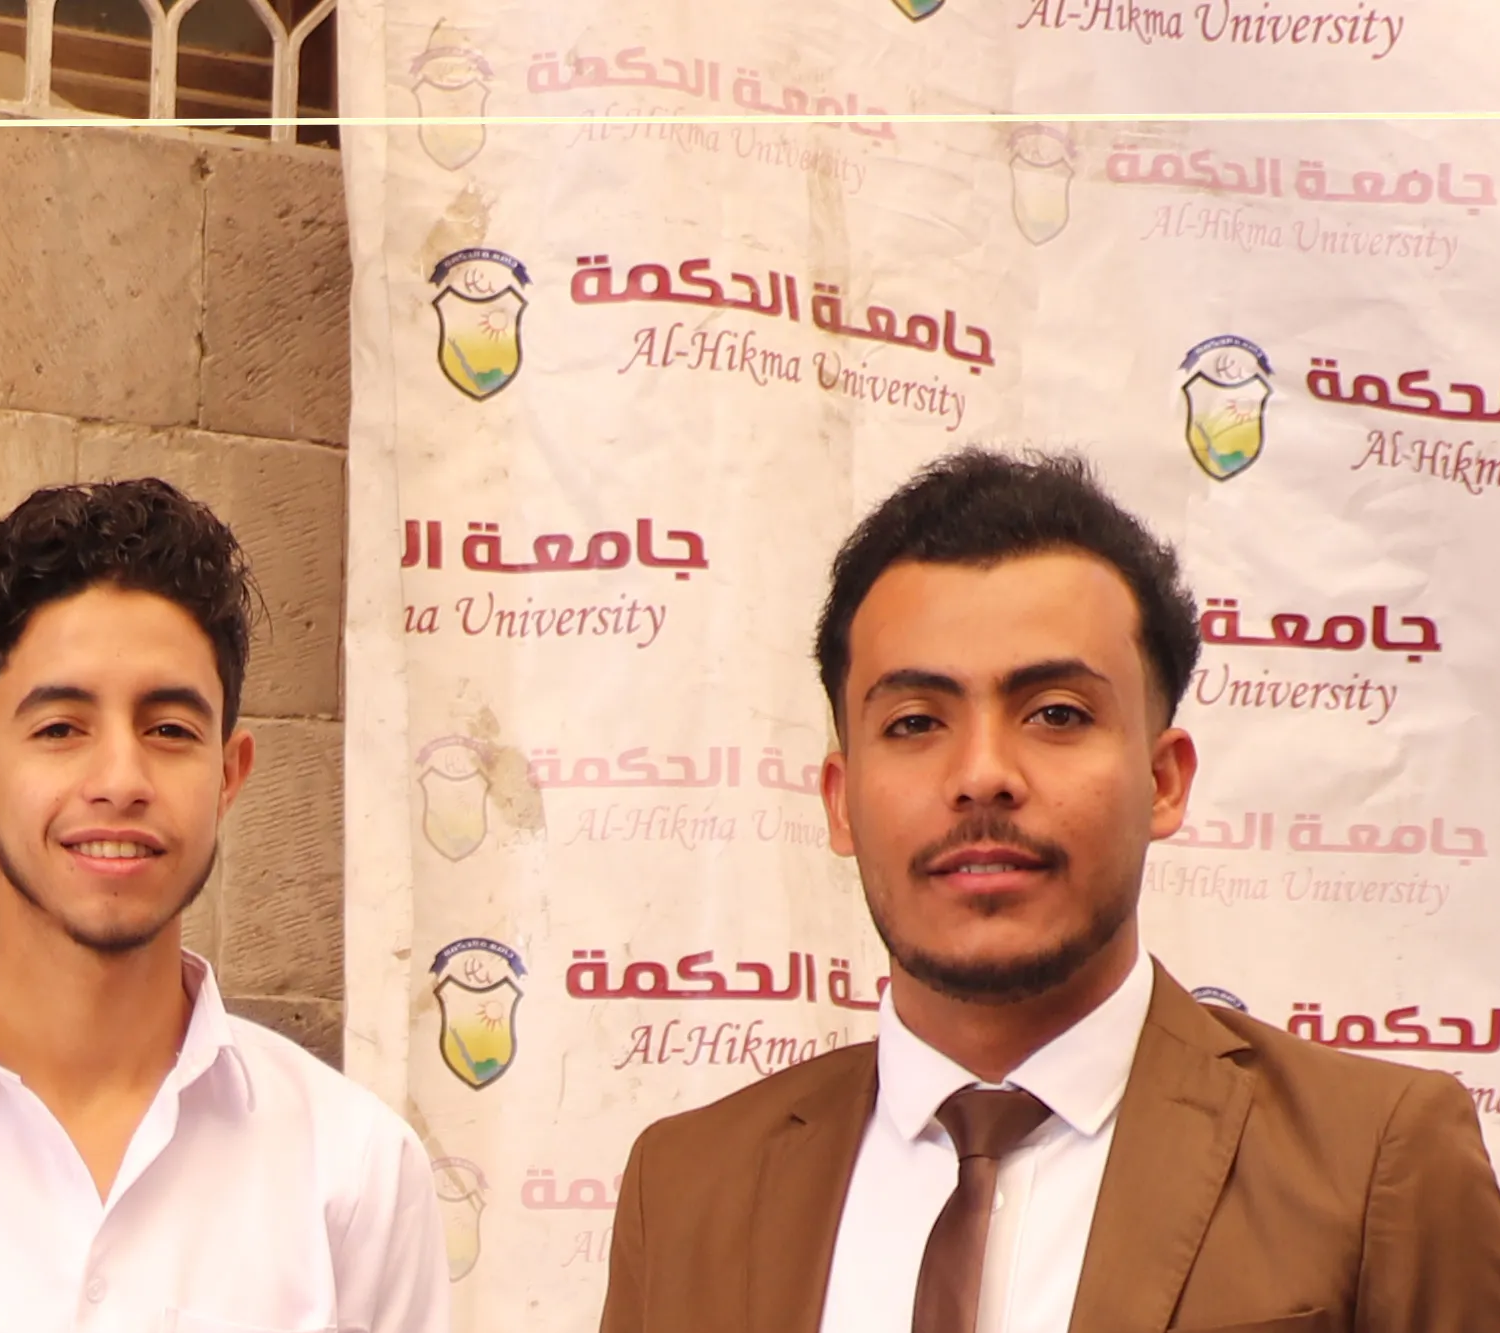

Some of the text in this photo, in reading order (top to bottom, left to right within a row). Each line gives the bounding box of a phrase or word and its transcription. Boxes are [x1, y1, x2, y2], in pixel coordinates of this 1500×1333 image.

[1106, 143, 1498, 216] جامعة الحكمة
[571, 254, 995, 374] جامعة الحكمة
[618, 323, 966, 431] Al-Hikma University
[462, 519, 709, 580] جامعة
[455, 594, 666, 649] University
[1288, 812, 1488, 867] جامعة
[566, 950, 817, 1002] الحكمة
